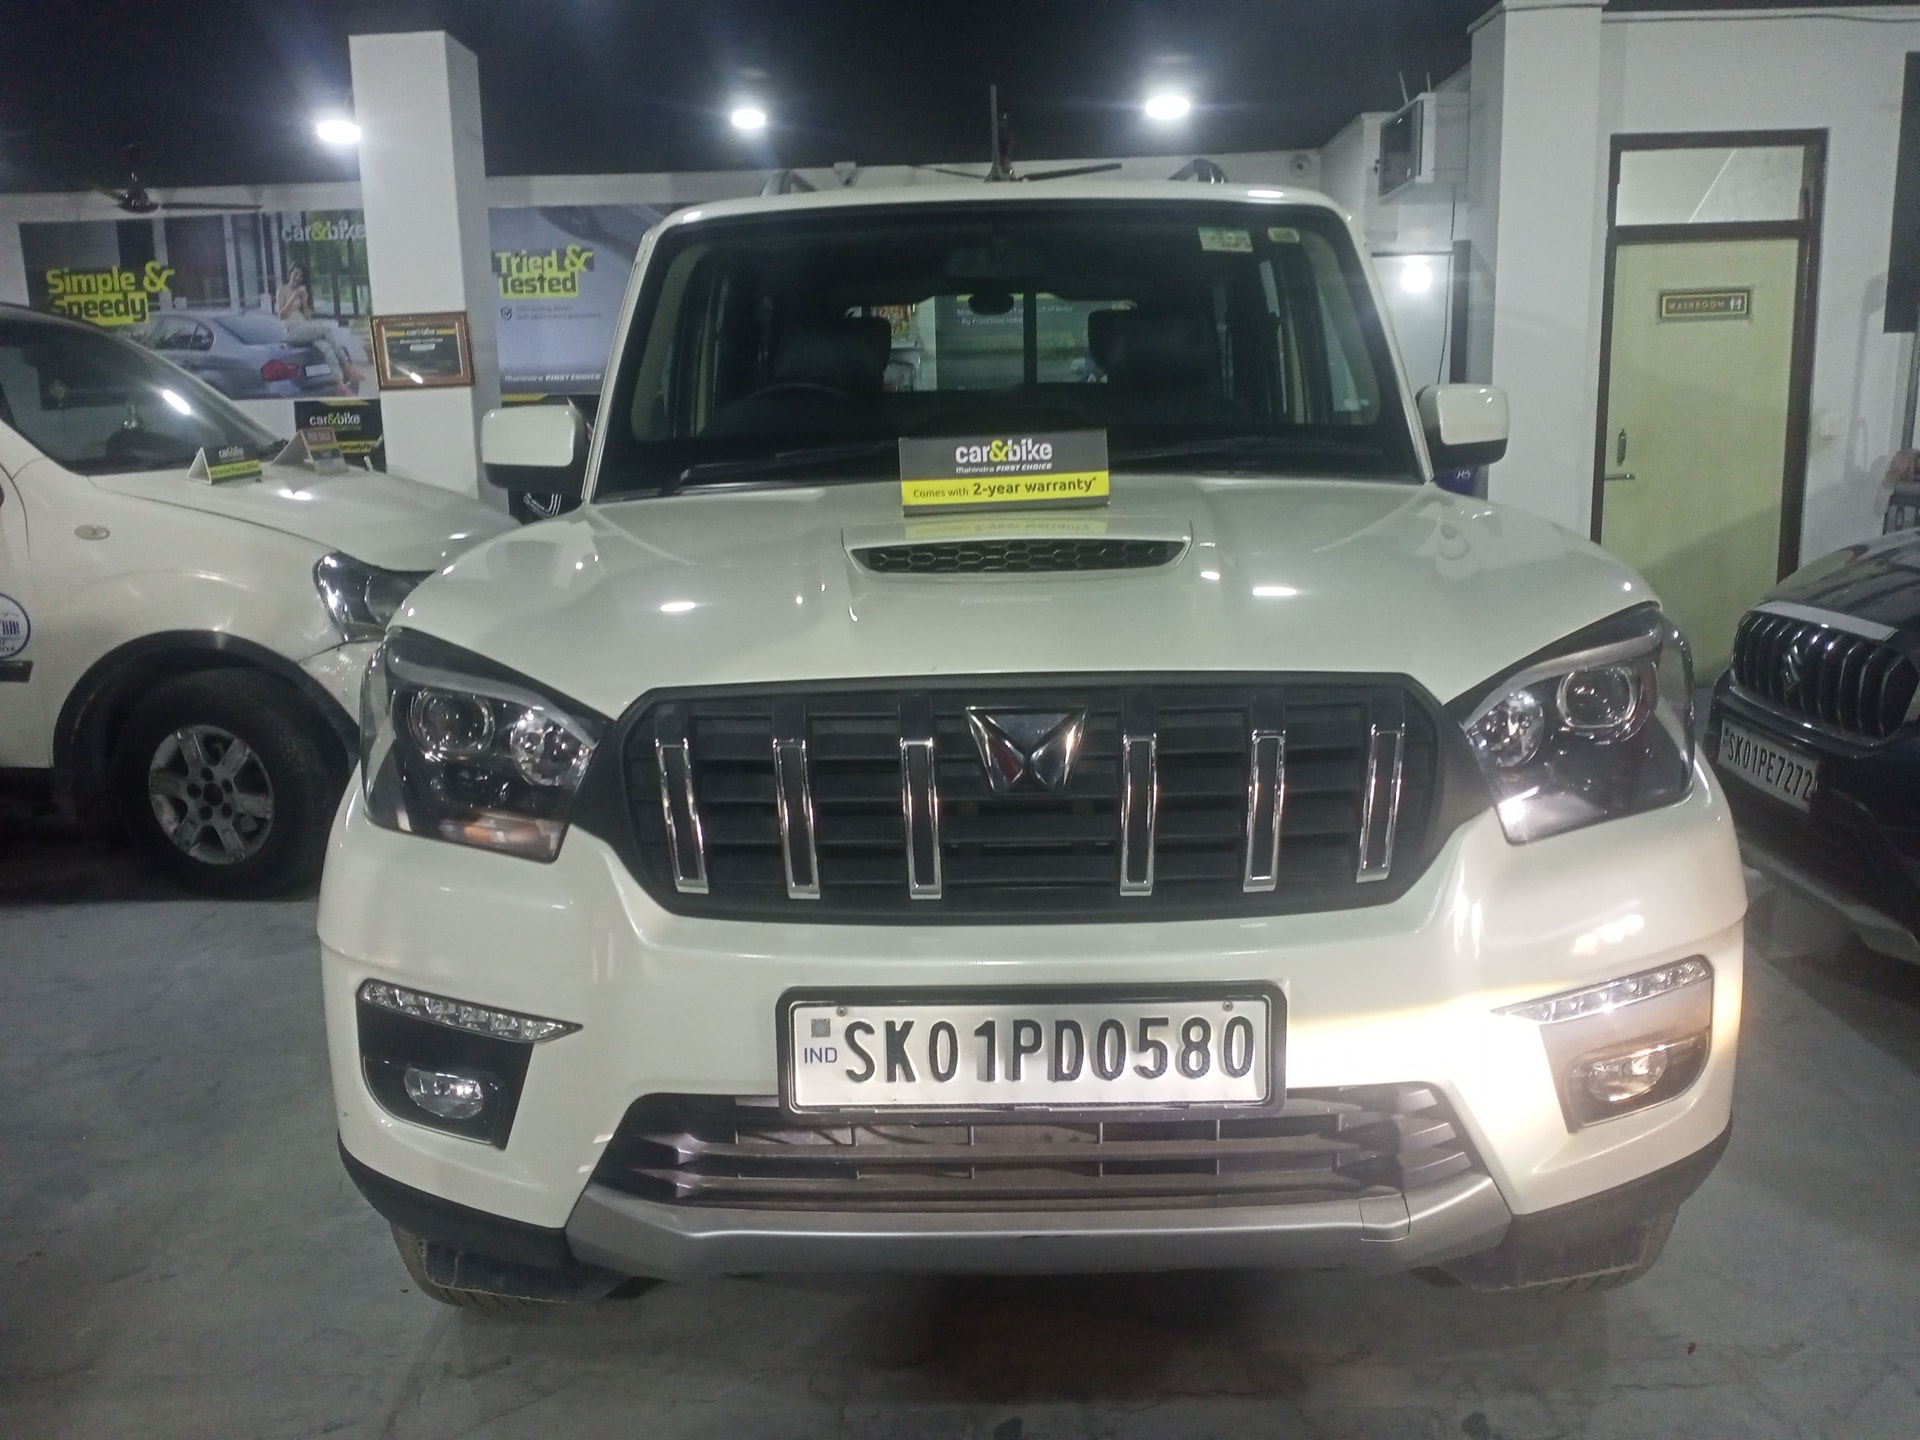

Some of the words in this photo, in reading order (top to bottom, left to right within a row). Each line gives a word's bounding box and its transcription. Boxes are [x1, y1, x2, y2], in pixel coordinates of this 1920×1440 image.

[495, 250, 558, 274] Tried
[564, 244, 594, 272] &
[46, 265, 136, 295] Simple
[143, 260, 175, 293] &
[497, 271, 577, 295] Tested
[309, 411, 361, 426] car&bike
[955, 438, 1053, 464] car&bike
[956, 466, 995, 475] Mahindra
[996, 464, 1021, 473] FIRST
[1021, 462, 1053, 471] CHOICE
[913, 489, 946, 499] Comes
[947, 487, 969, 497] with
[973, 482, 1020, 498] 2-year
[1727, 733, 1813, 800] SK01PE7272
[804, 1047, 838, 1064] IND
[845, 1015, 1254, 1083] SK01PD0580
